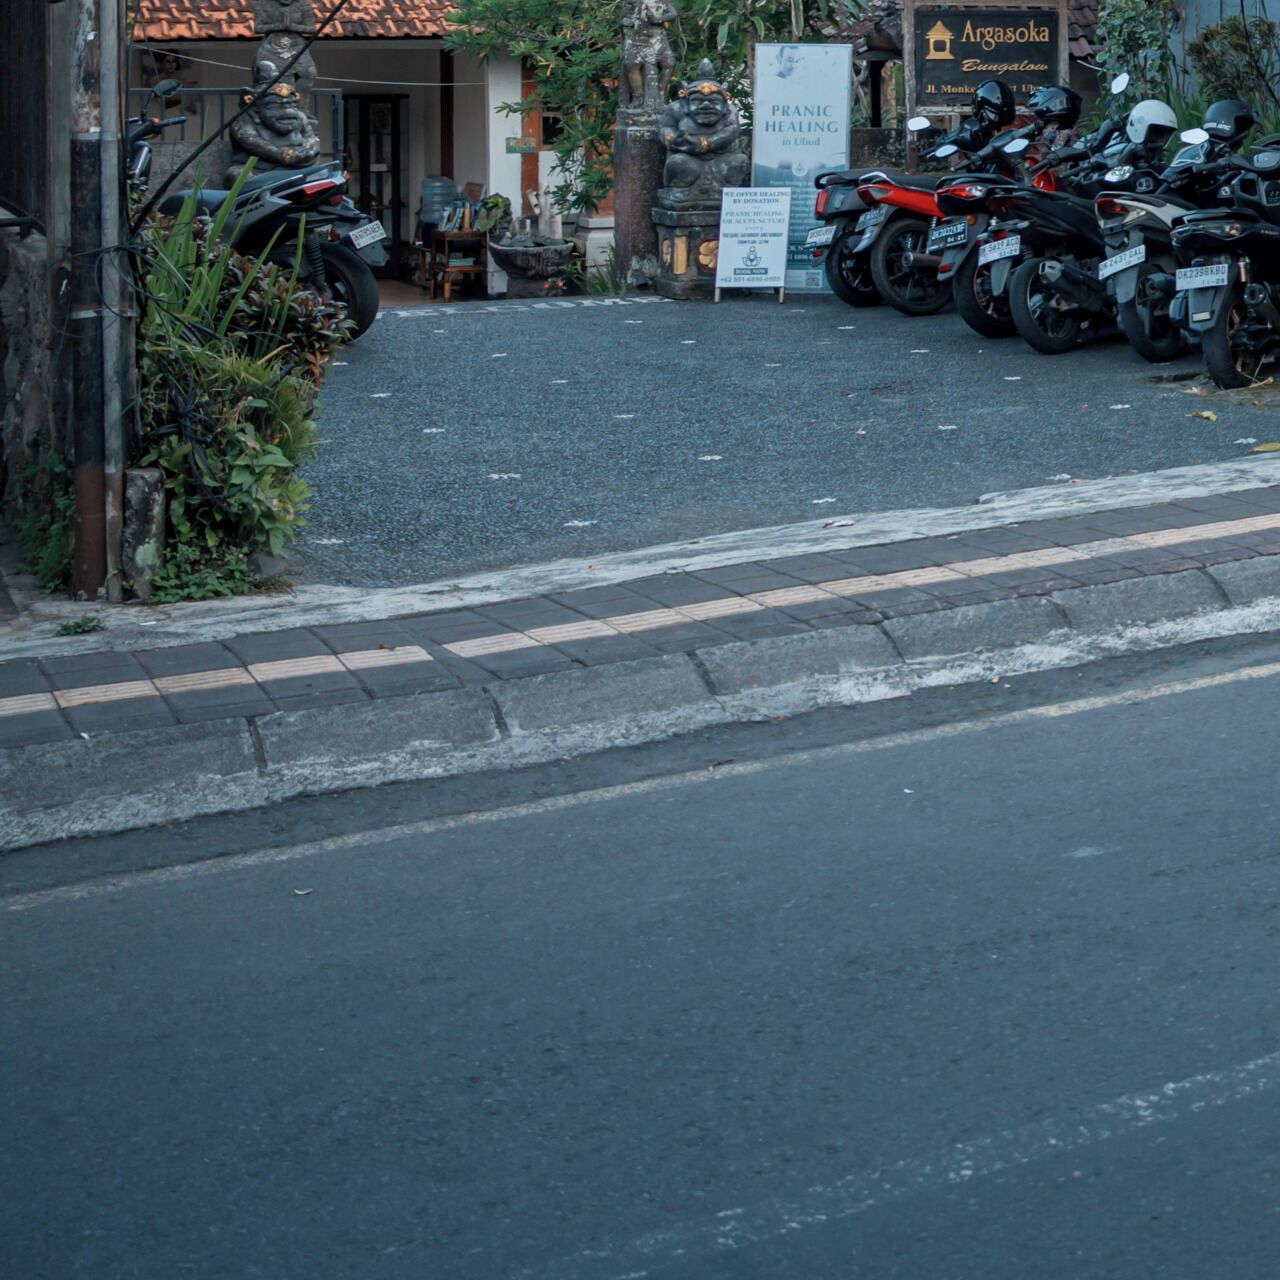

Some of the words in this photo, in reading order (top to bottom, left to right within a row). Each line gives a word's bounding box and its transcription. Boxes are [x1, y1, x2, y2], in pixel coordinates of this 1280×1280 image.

[961, 19, 1049, 51] Argasoka
[961, 58, 1048, 74] Bungalow
[941, 84, 976, 94] Monke
[771, 104, 833, 117] PRANIC
[765, 120, 839, 133] HEALING
[782, 136, 792, 146] in
[793, 135, 821, 146] Ubud
